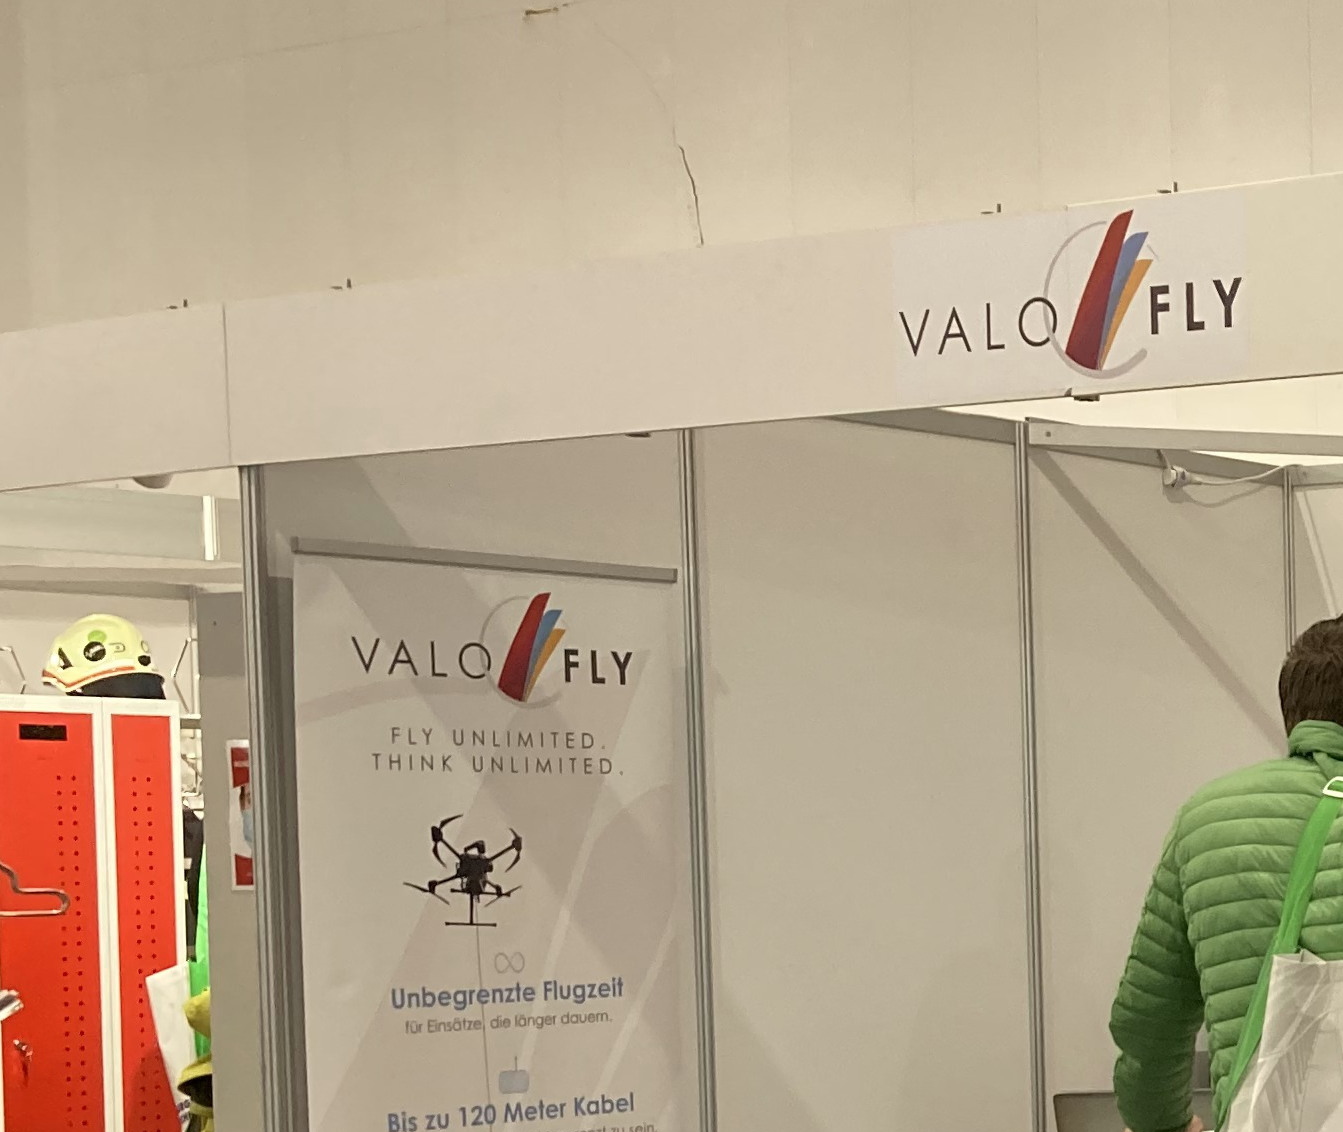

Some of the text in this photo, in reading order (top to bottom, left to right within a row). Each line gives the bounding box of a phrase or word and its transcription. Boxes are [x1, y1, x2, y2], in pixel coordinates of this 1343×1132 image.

[899, 277, 1243, 356] VALO FLY
[352, 636, 633, 685] VALO FLY
[391, 727, 605, 750] FLY UNLIMITED.
[372, 753, 624, 776] THINK UNLIMITED.
[391, 977, 624, 1011] Unbegrenzte Flugzeit
[405, 1021, 422, 1034] für
[490, 1015, 511, 1029] die
[514, 1013, 556, 1029] länger
[561, 1011, 612, 1025] dauern.
[425, 1113, 450, 1131] zu
[458, 1104, 497, 1127] 120
[504, 1099, 566, 1123] Meter
[574, 1092, 634, 1117] Kabel
